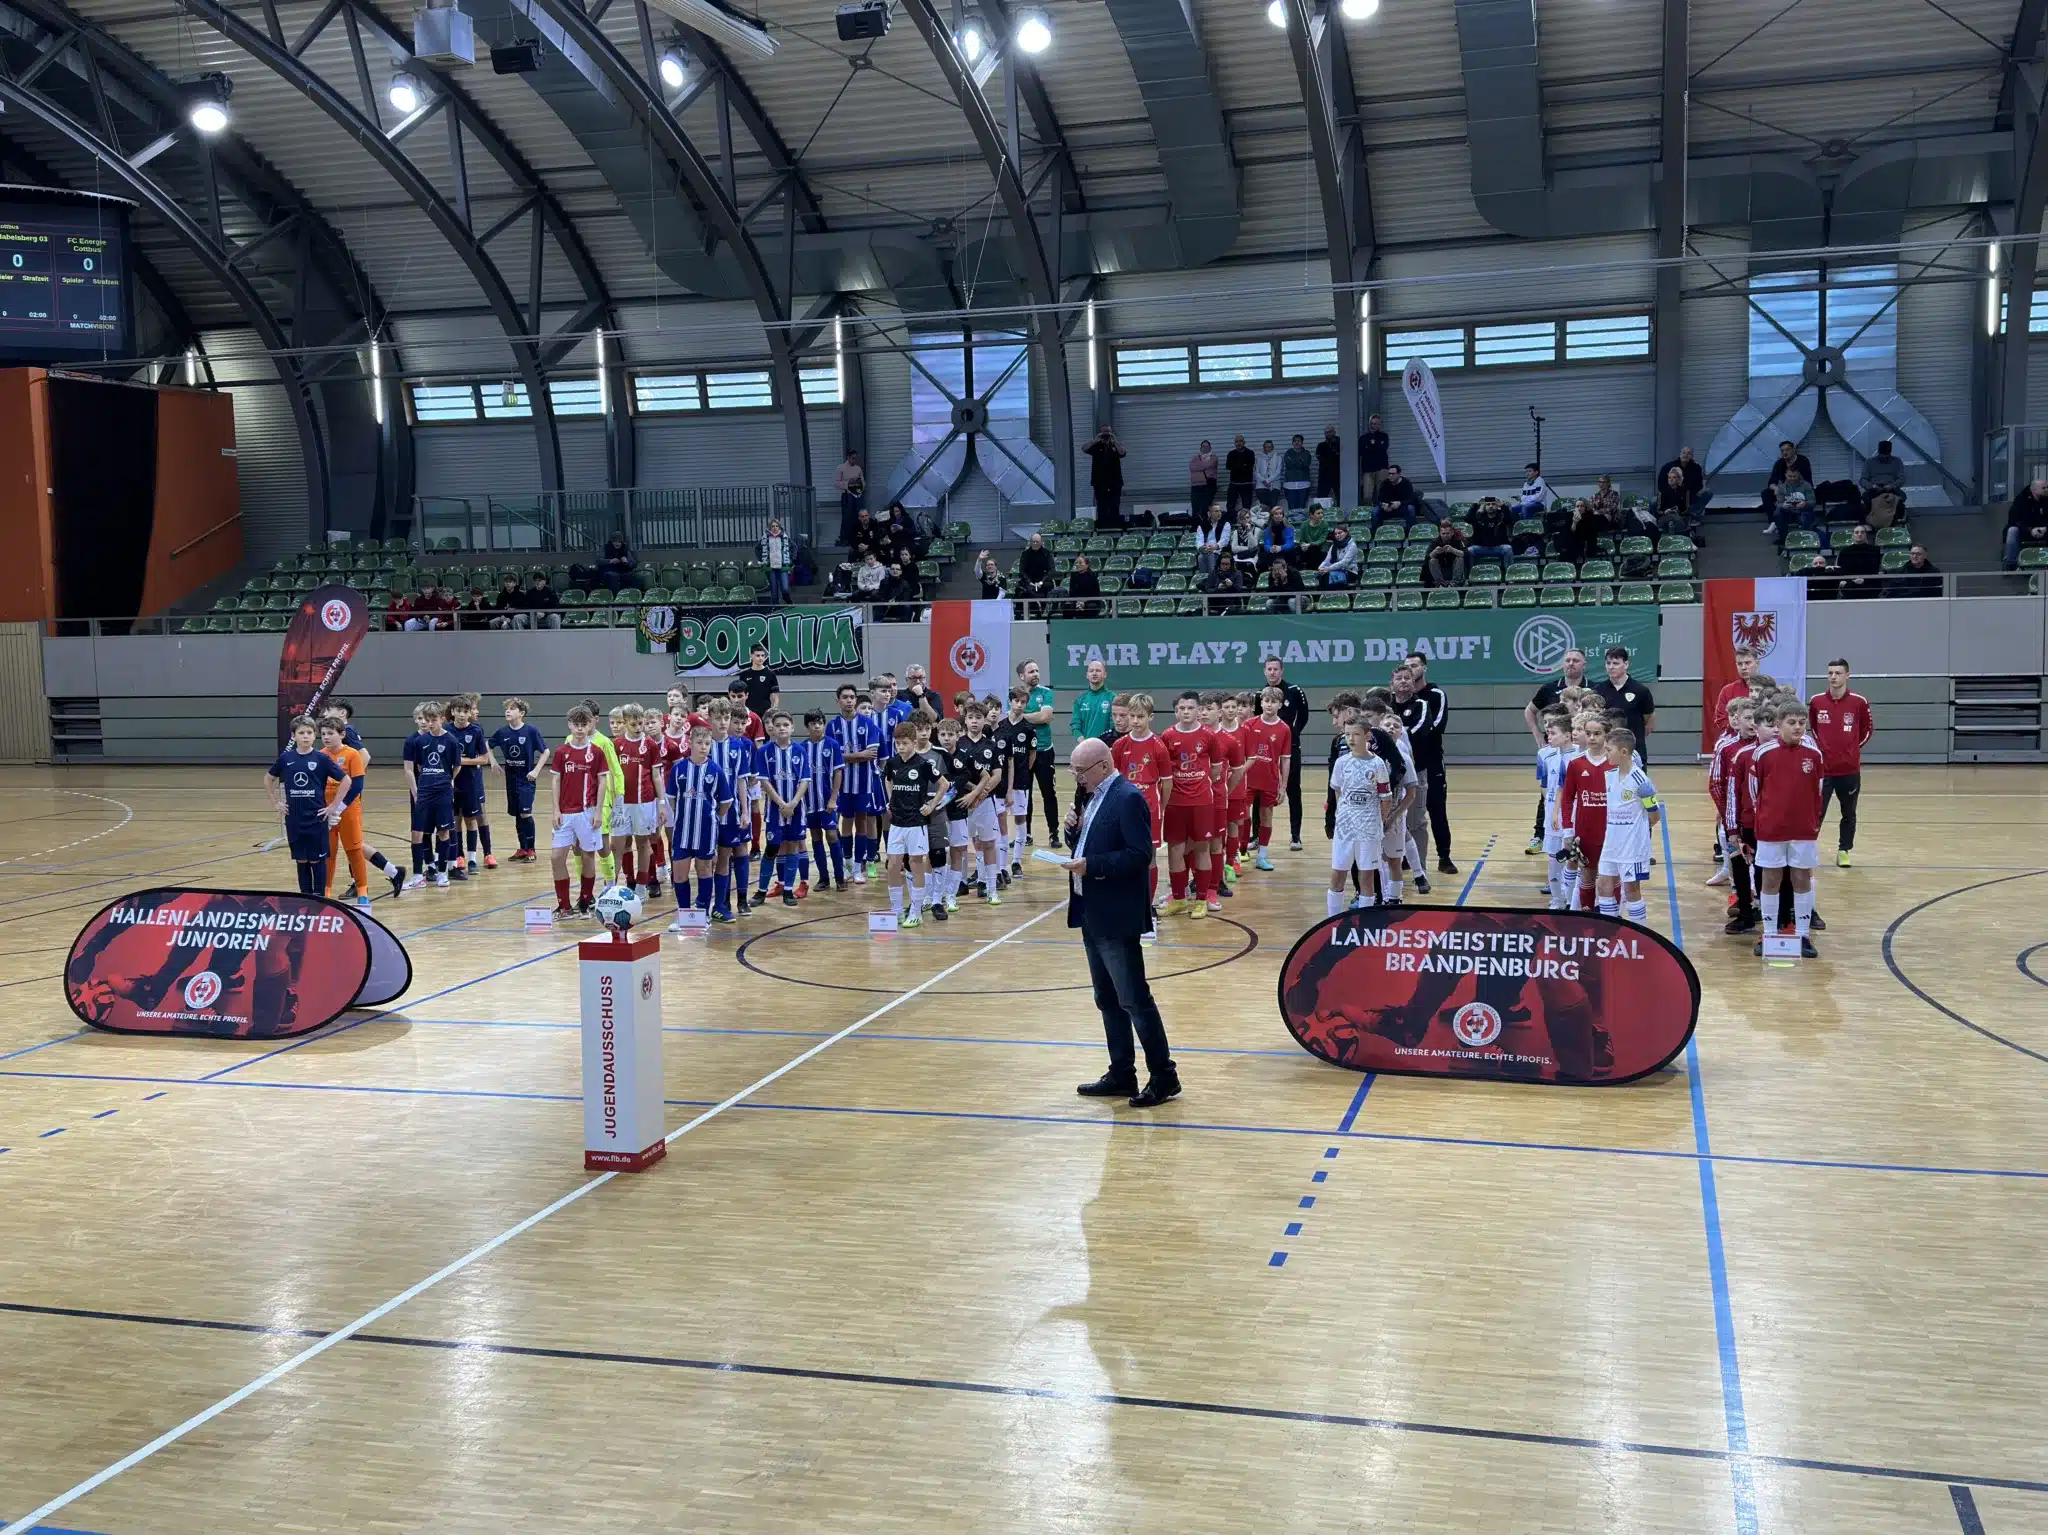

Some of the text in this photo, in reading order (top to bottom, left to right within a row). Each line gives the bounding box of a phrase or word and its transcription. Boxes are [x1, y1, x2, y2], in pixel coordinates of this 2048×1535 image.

[79, 238, 106, 246] Energie
[12, 254, 23, 268] 0
[83, 258, 93, 271] 0
[676, 614, 860, 668] BORNIM
[1600, 633, 1624, 644] Fair
[1066, 636, 1491, 666] FAIR PLAY? HAND DRAUF!
[1585, 647, 1600, 658] ist
[320, 667, 334, 690] ECHTE
[332, 643, 350, 668] PROFIS.
[110, 907, 344, 934] HALLENLANDESMEISTER
[167, 930, 271, 950] JUNIOREN
[1331, 927, 1644, 960] LANDESMEISTER FUTSAL
[1386, 952, 1580, 981] BRANDENBURG
[600, 975, 616, 1139] JUGENDAUSSCHUSS
[1394, 1048, 1552, 1065] UNSERE AMATEURE. ECHTE PROFIS.
[591, 1155, 631, 1163] www.flb.de
